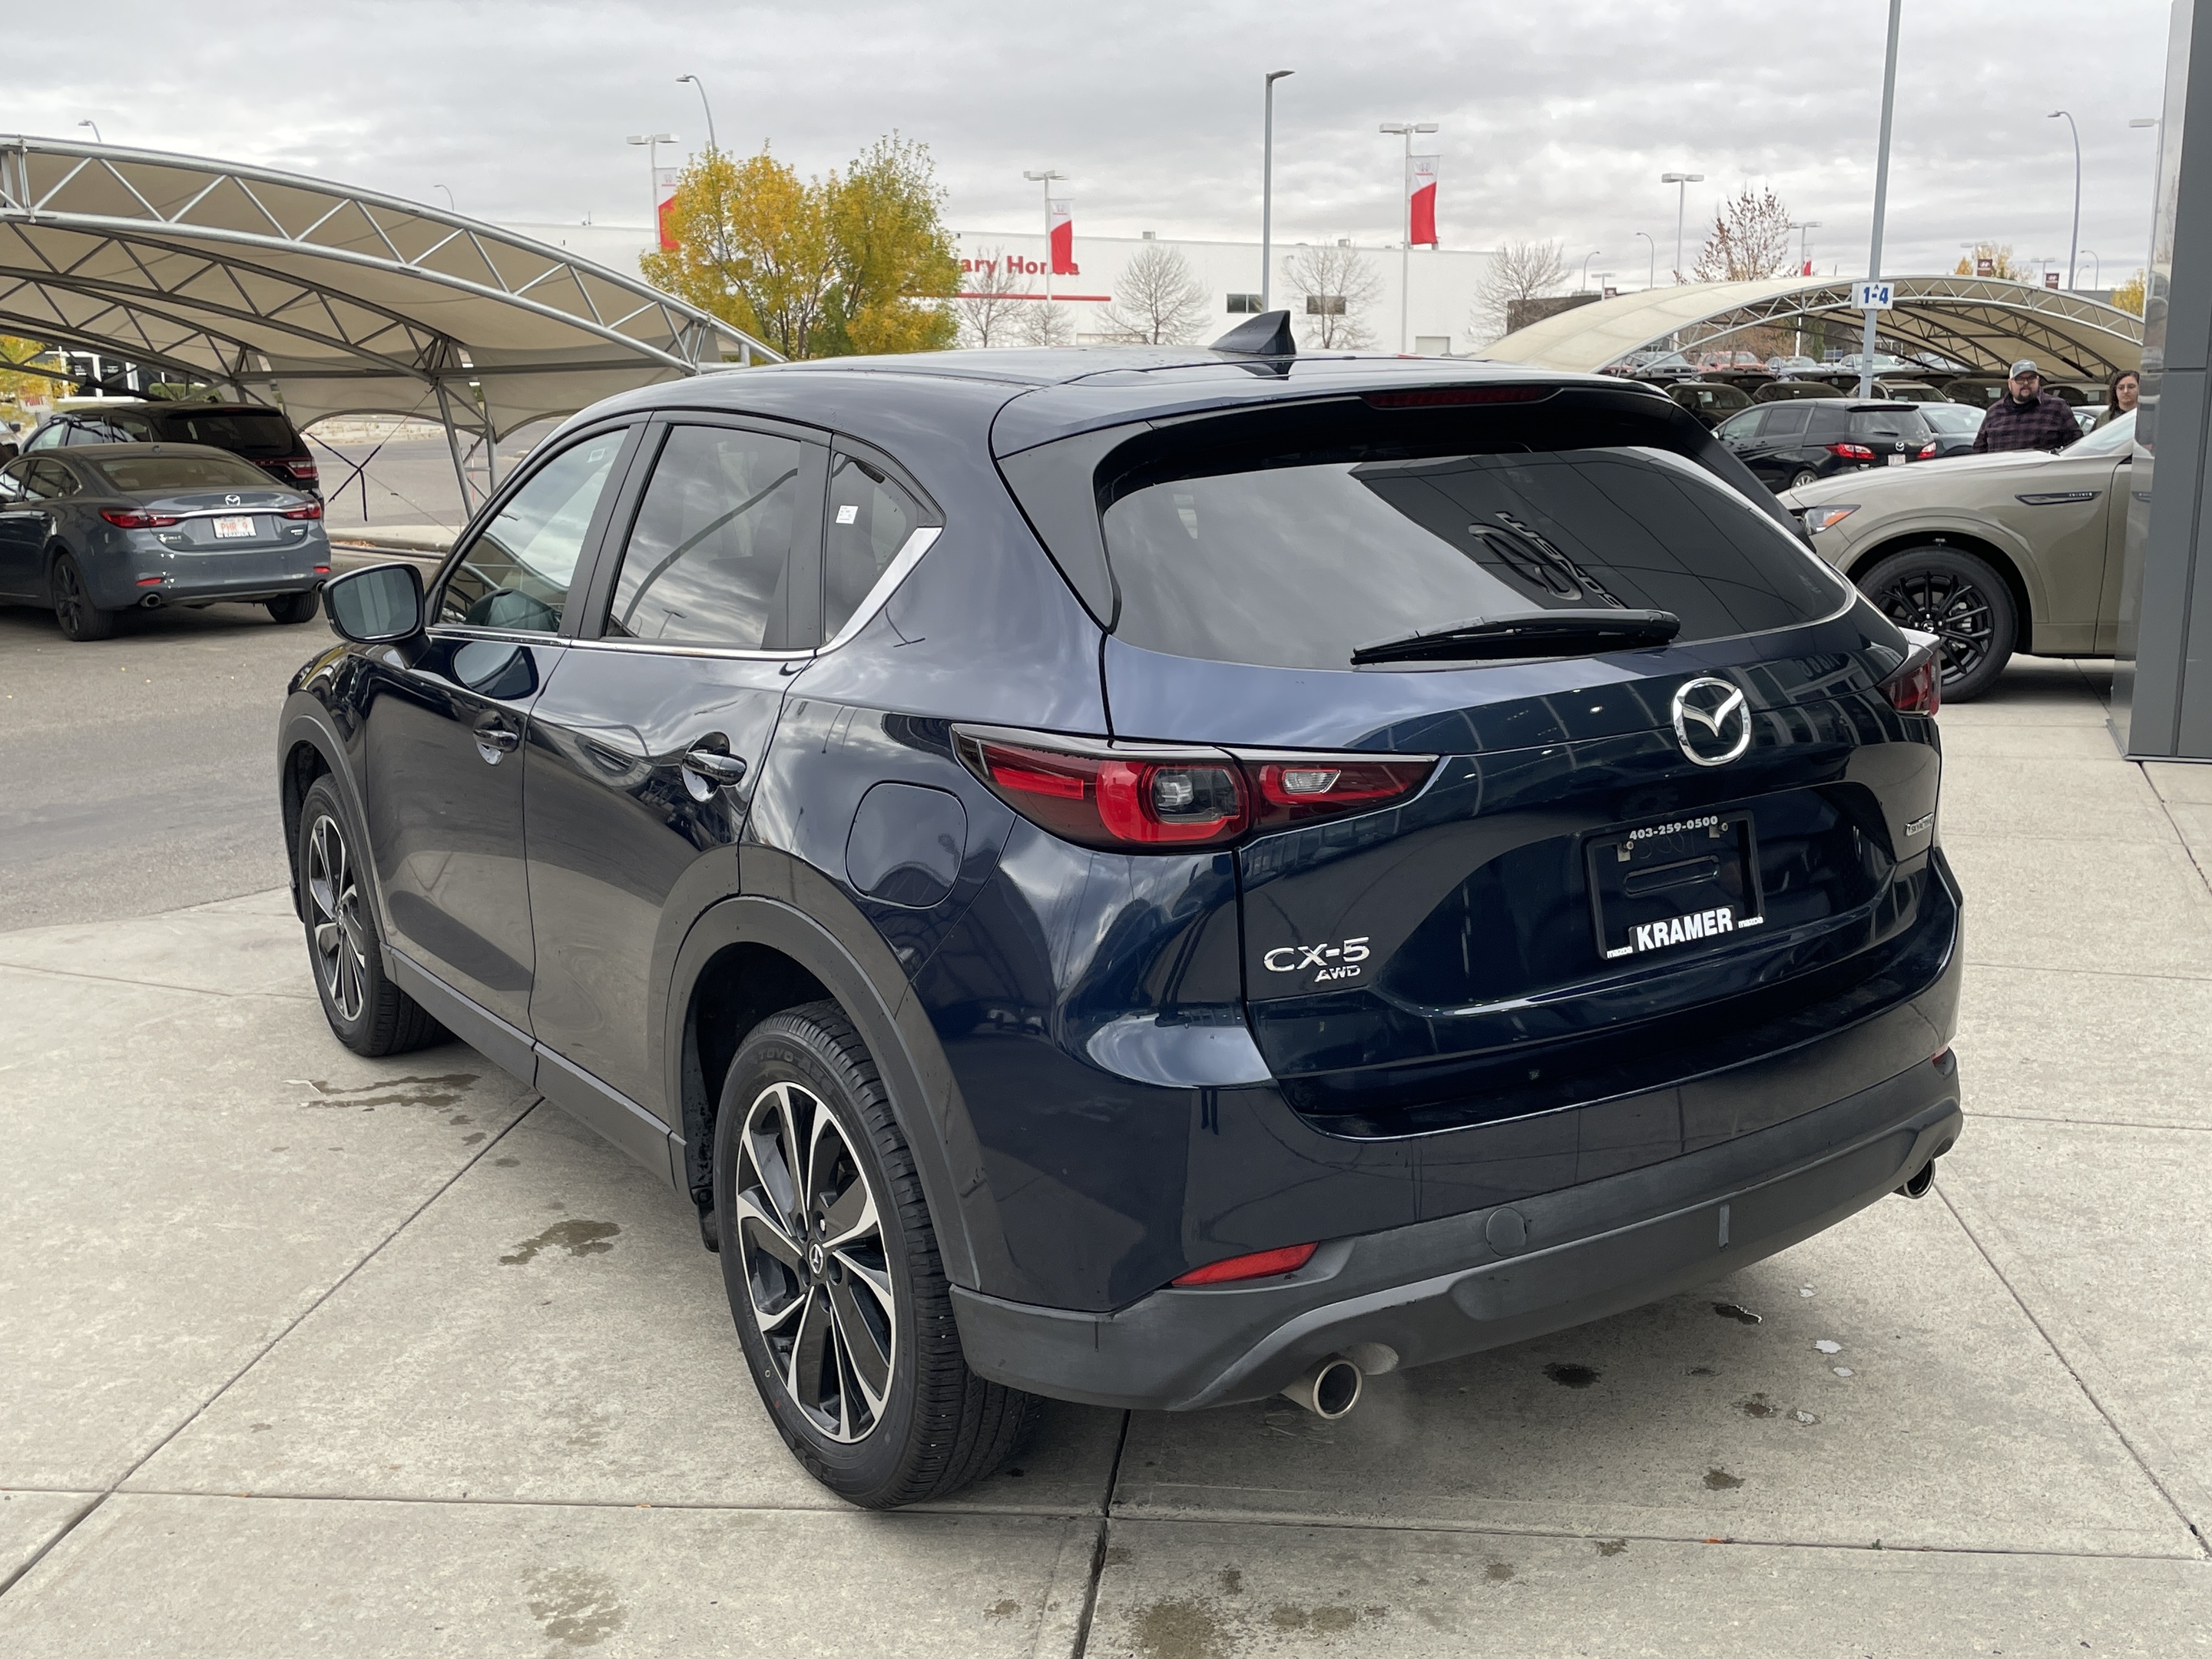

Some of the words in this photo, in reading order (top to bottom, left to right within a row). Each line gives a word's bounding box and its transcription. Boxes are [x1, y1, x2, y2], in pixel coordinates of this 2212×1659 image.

[1863, 286, 1889, 304] 1-4
[1629, 815, 1719, 840] 403-259-0500
[1636, 907, 1734, 952] KRAMER
[1263, 936, 1370, 972] CX-5
[1314, 965, 1361, 983] AWD
